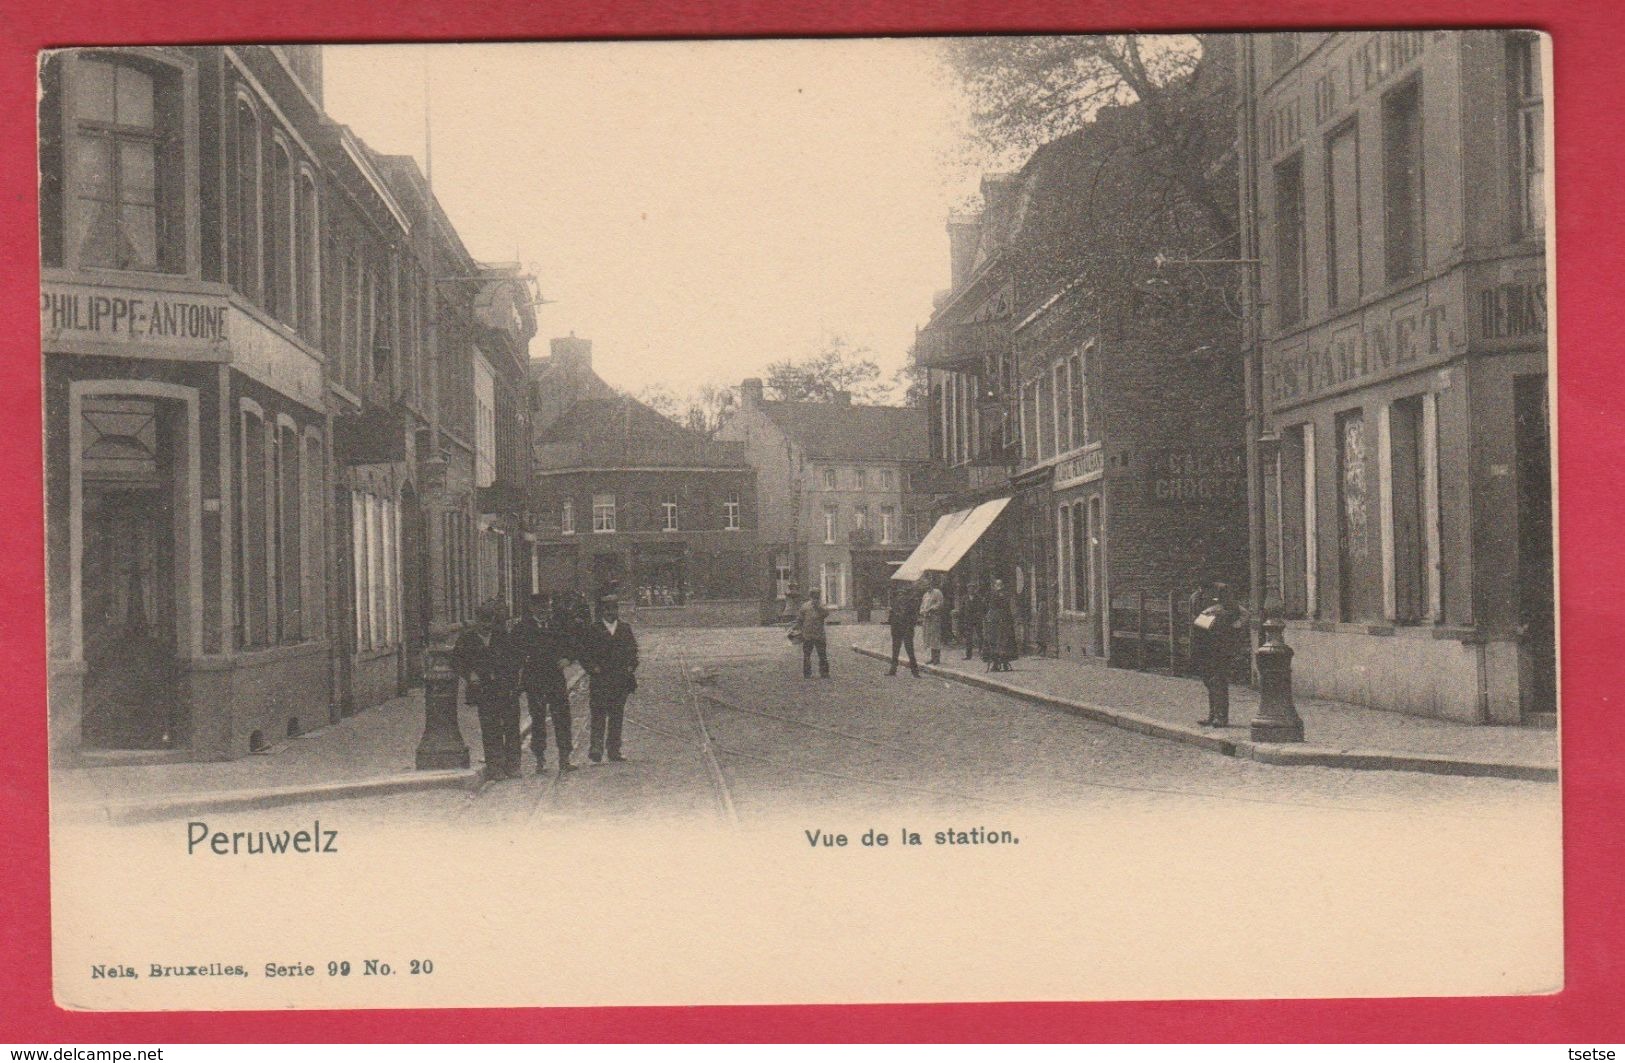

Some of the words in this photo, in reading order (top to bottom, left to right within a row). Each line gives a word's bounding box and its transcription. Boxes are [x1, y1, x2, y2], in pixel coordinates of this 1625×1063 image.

[187, 820, 339, 855] Peruwelz
[805, 829, 848, 847] Vue
[861, 828, 889, 846] de
[901, 828, 923, 846] la
[934, 826, 1020, 845] station.
[91, 964, 139, 980] Nels,
[148, 963, 249, 979] Bruxelles,
[264, 961, 315, 977] Serie
[327, 960, 351, 977] 99
[363, 960, 397, 976] No.
[409, 959, 434, 975] 20
